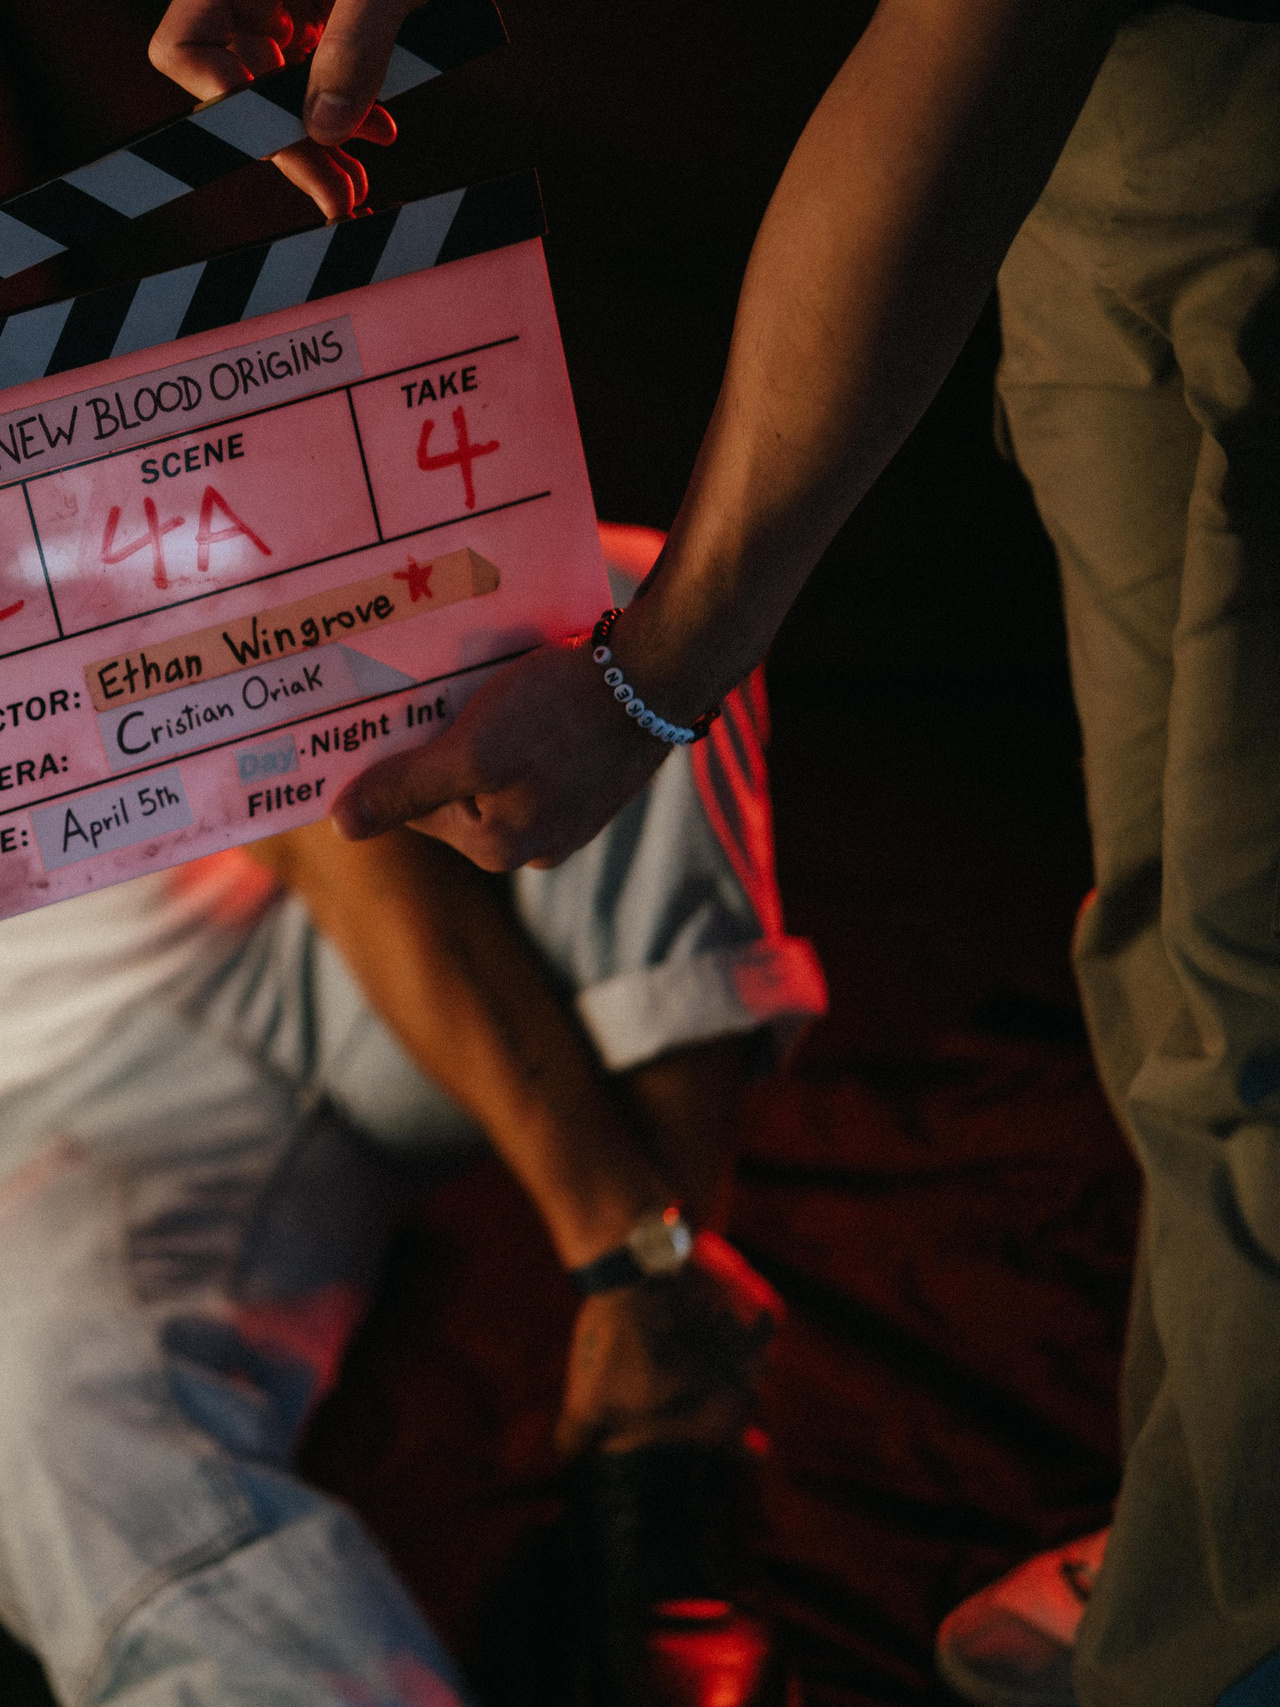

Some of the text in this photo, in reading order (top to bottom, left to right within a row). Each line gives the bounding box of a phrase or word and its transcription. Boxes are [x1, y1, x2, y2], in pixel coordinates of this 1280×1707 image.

[86, 376, 202, 441] BLOOD
[401, 365, 478, 408] TAKE
[141, 432, 246, 485] SCENE
[416, 405, 500, 510] 4
[100, 484, 273, 590] 4A
[97, 595, 396, 700] Ethan Wingrove
[116, 703, 235, 756] Cristian
[406, 697, 446, 729] Int
[62, 785, 180, 853] April 5th
[248, 776, 326, 818] Filter
